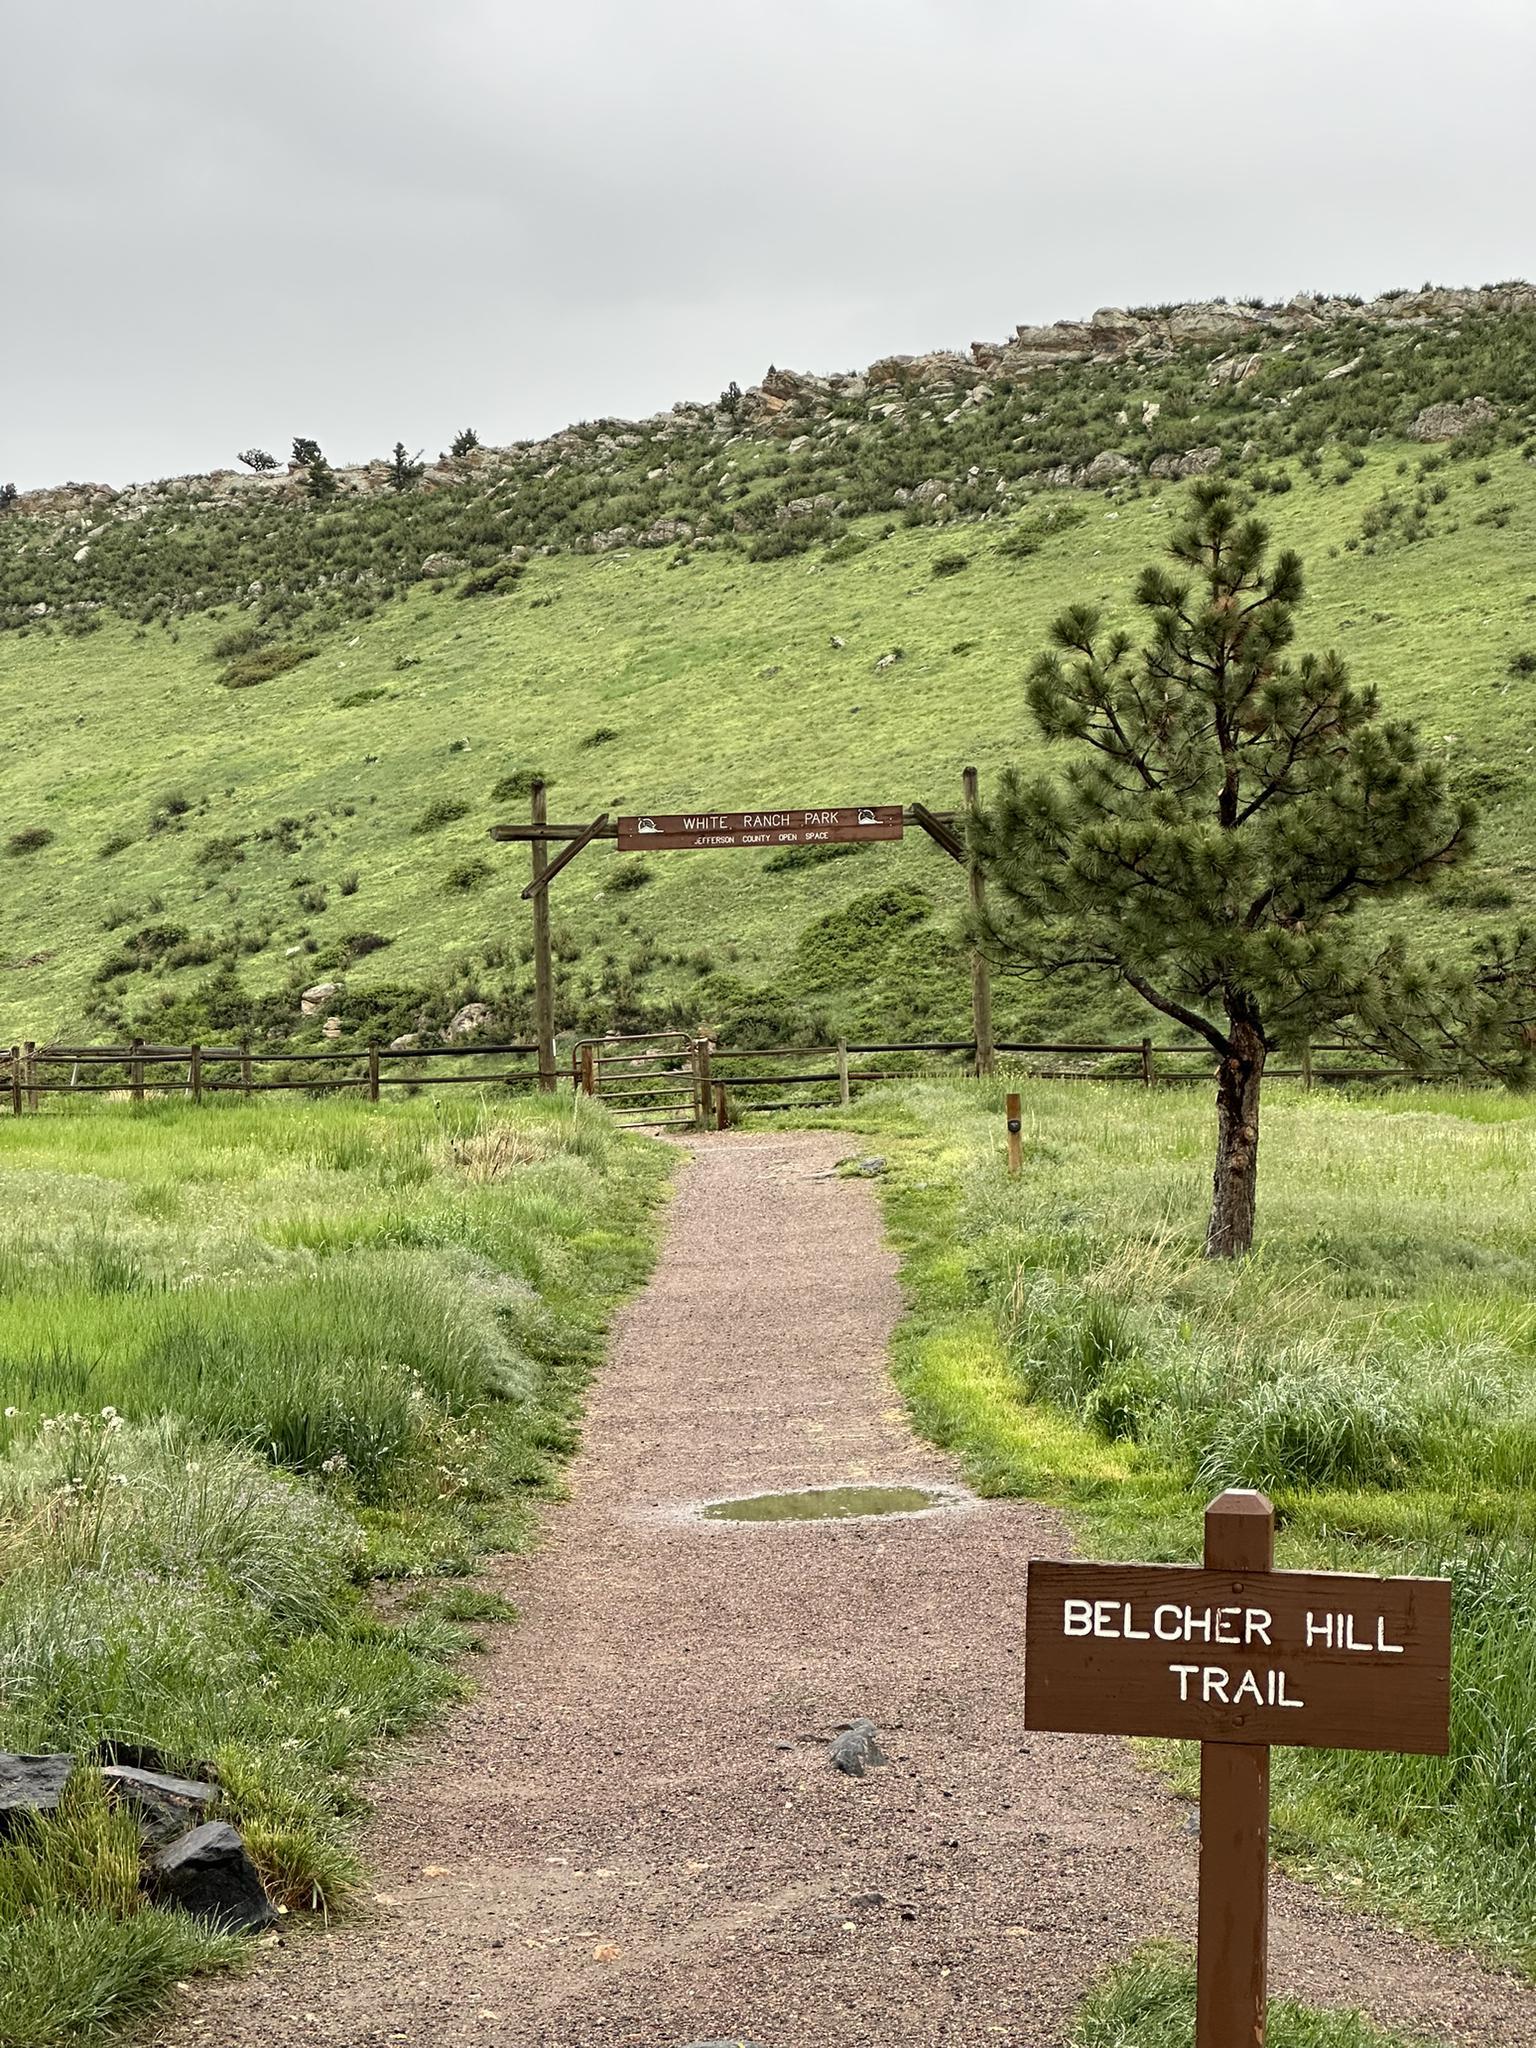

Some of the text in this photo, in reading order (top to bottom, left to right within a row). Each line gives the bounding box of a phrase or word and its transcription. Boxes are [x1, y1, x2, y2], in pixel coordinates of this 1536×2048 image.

[683, 811, 839, 830] WHITE RANCH PARK
[742, 834, 771, 843] COUNTY
[778, 833, 797, 842] OPEN
[805, 832, 829, 840] SPACE
[1063, 1599, 1405, 1653] BELCHER HILL
[1168, 1664, 1305, 1708] TRAIL
